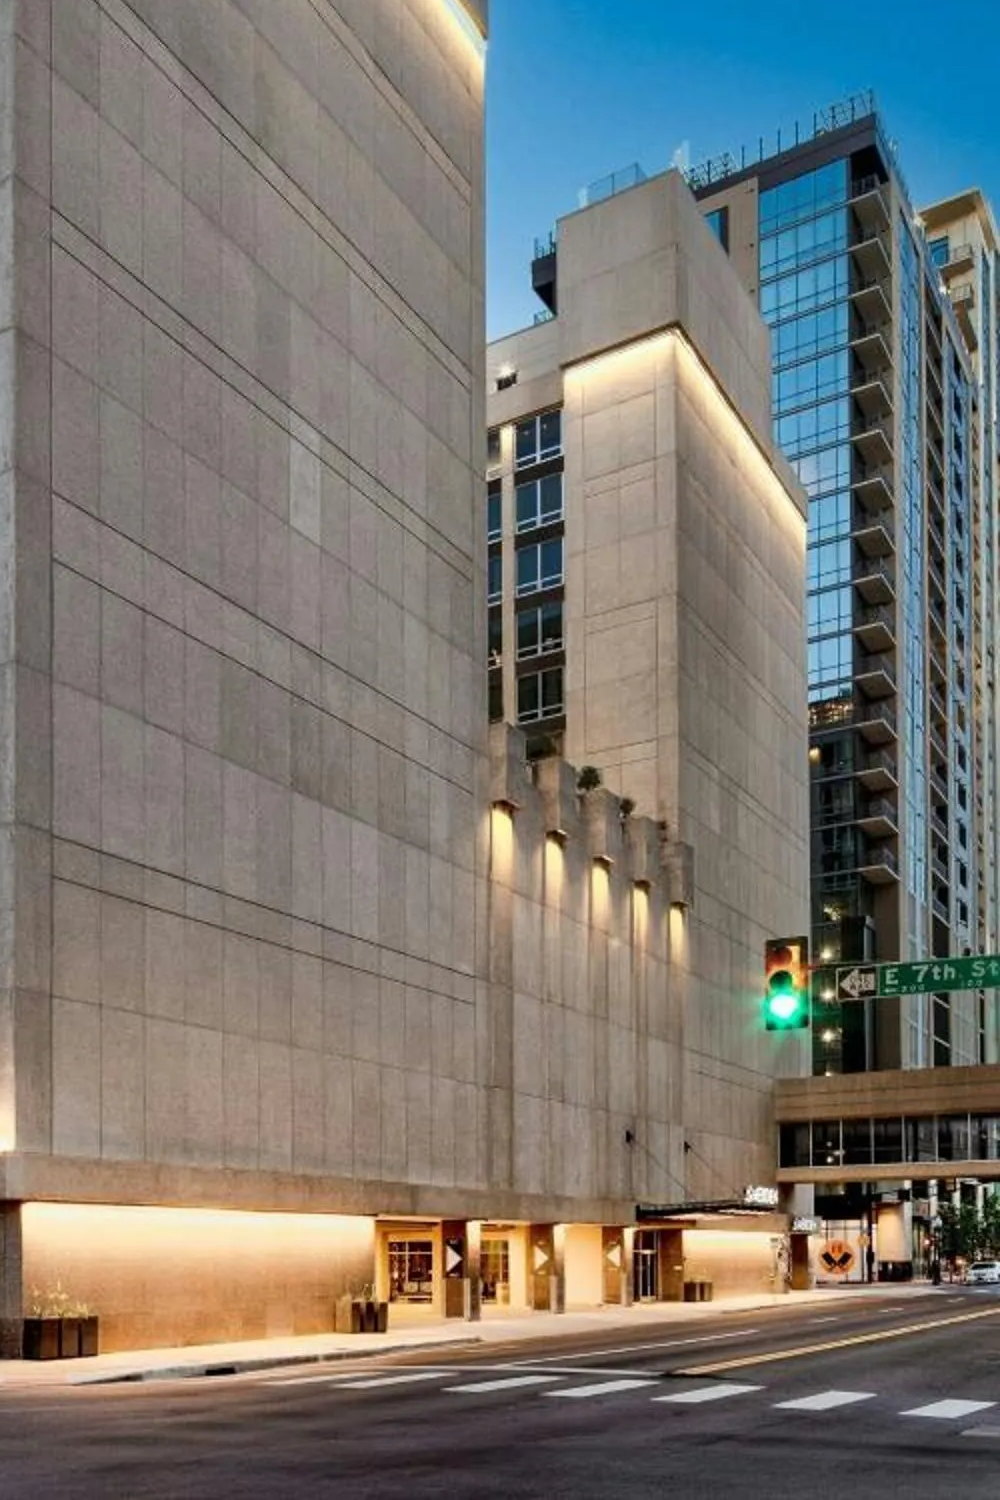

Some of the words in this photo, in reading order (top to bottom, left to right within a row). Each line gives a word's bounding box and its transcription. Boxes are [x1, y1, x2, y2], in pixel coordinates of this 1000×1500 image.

[885, 968, 899, 985] E
[911, 964, 956, 983] 7th
[971, 960, 1000, 977] St
